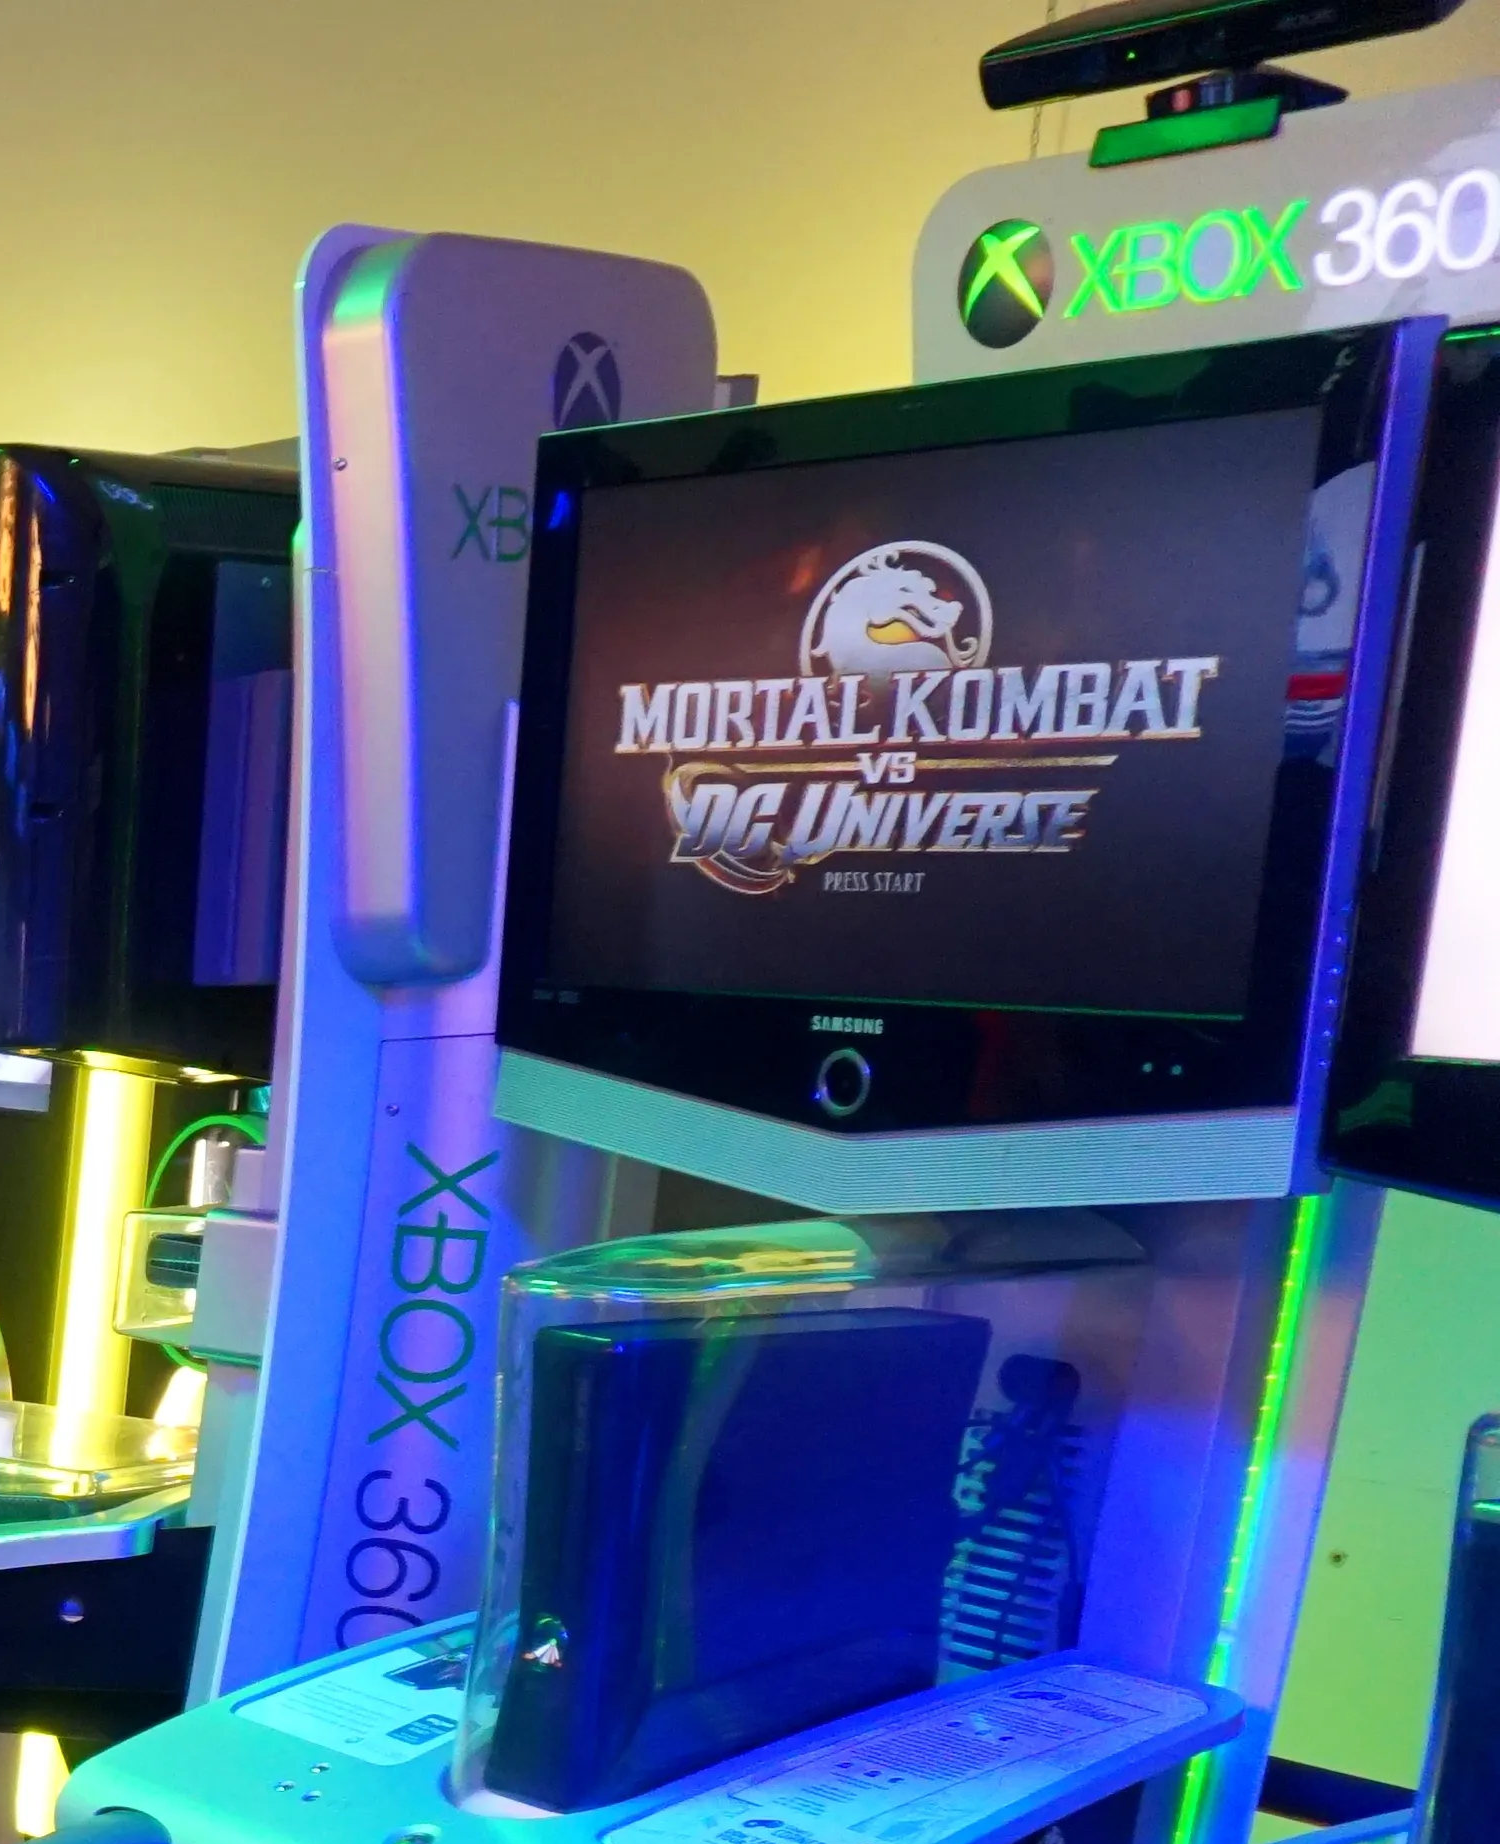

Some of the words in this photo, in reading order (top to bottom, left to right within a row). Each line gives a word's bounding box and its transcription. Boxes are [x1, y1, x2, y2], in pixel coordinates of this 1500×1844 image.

[1064, 198, 1310, 319] XBOX
[1312, 168, 1498, 288] 360
[615, 670, 883, 755] MORTAL
[888, 655, 1220, 749] KOMBAT
[855, 750, 916, 785] VS
[672, 781, 780, 862] DC
[784, 783, 1099, 864] UNIVERSE
[823, 870, 868, 893] PRESS
[872, 870, 925, 894] START
[810, 1013, 885, 1037] SAMSUNG
[368, 1141, 500, 1452] XBOX
